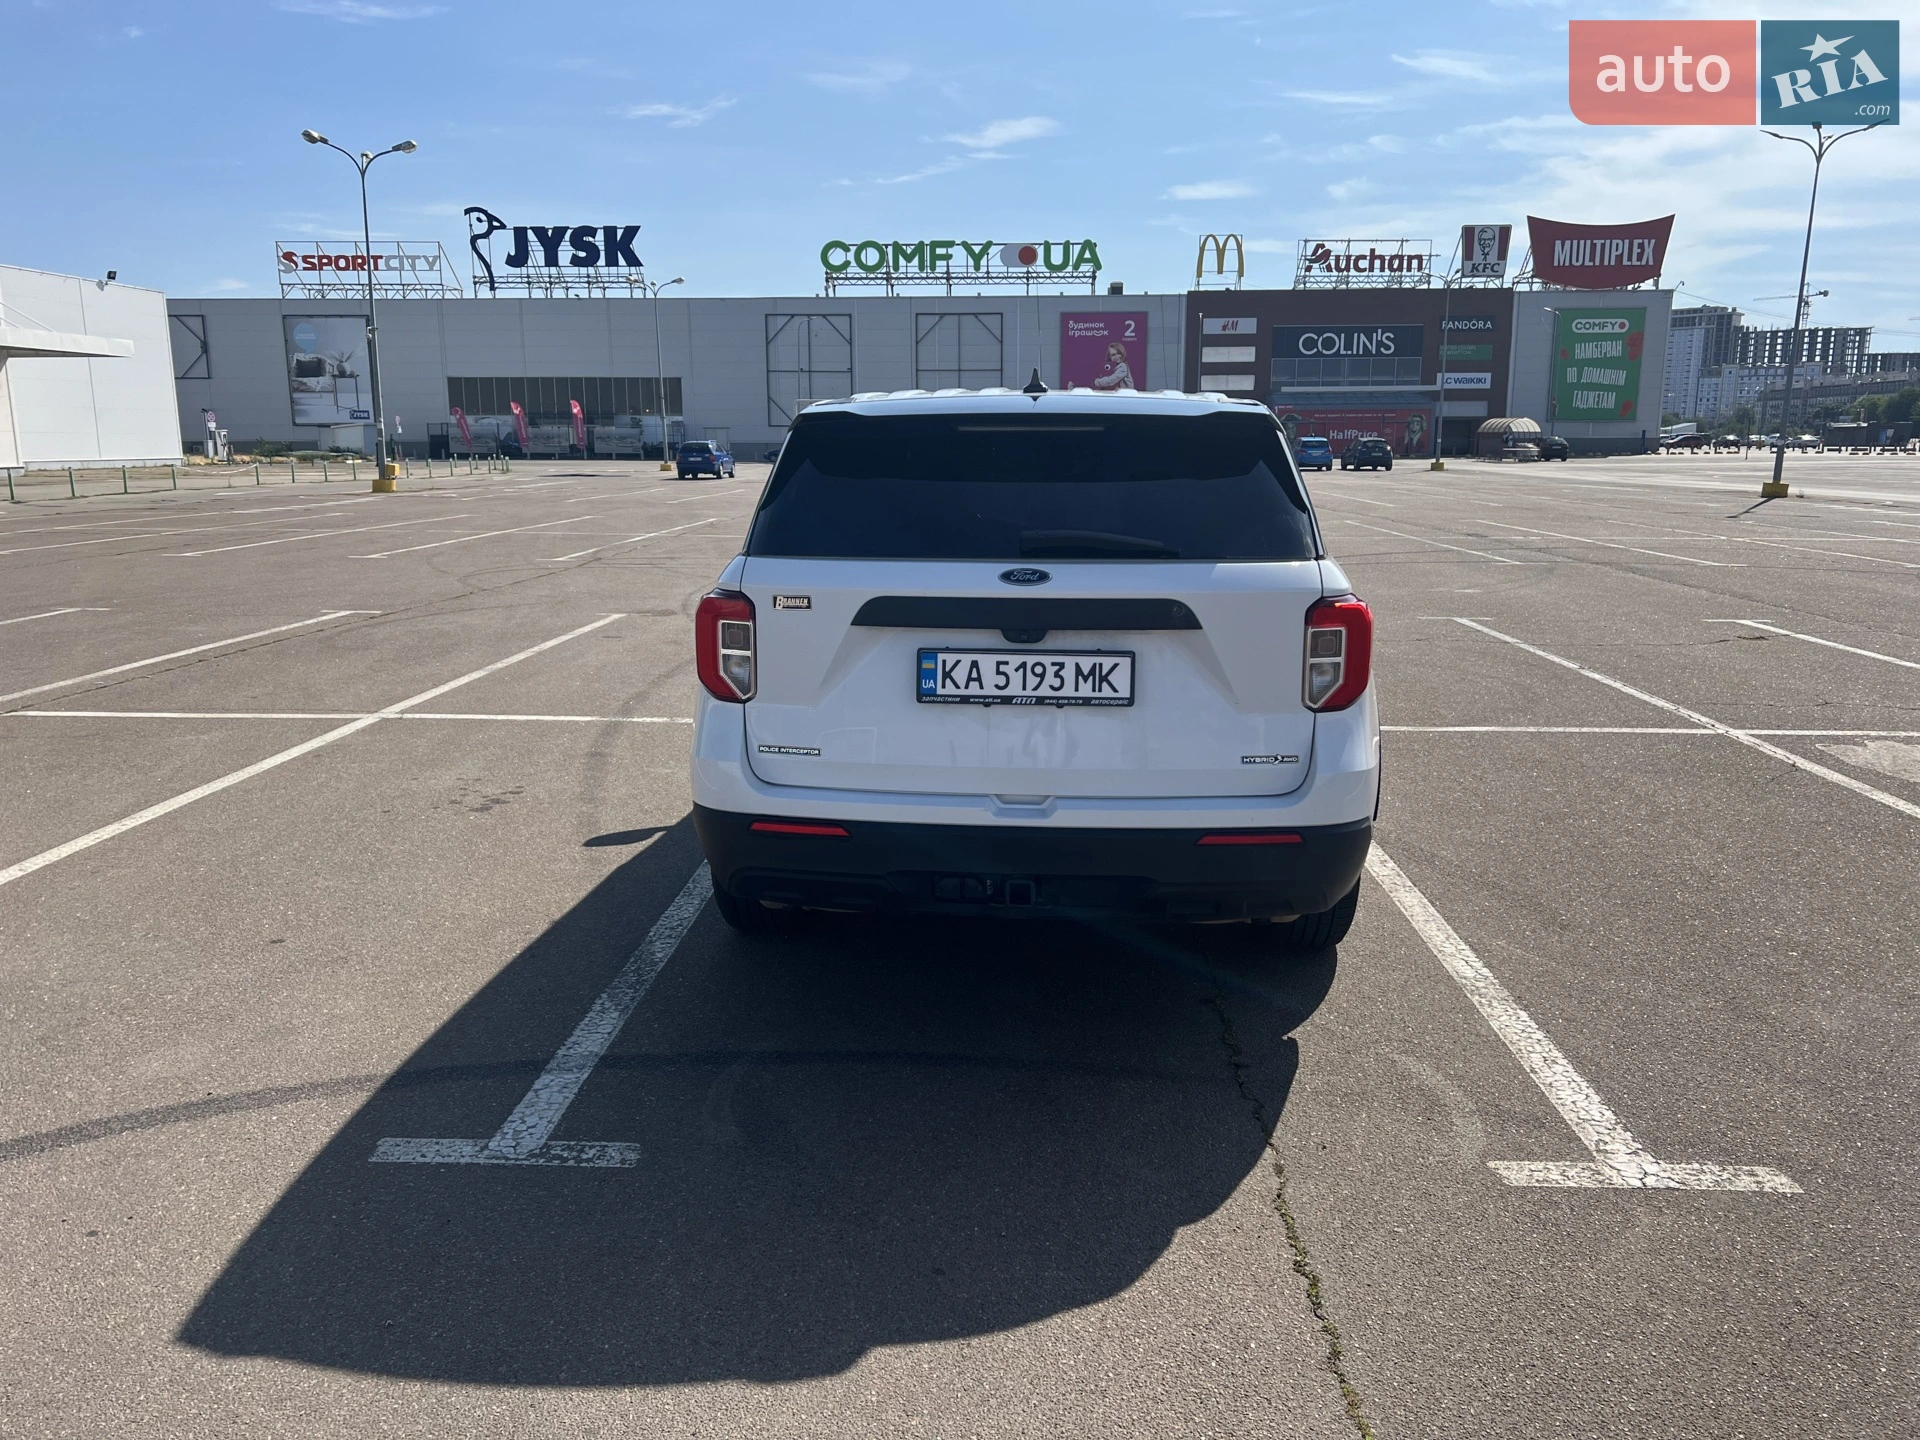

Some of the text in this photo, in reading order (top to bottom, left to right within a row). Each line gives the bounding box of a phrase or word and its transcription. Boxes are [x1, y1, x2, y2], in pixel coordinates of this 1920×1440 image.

[505, 225, 644, 268] JYSK
[820, 239, 1103, 273] COMFY UA
[1553, 239, 1656, 267] MULTIPLEX
[1304, 243, 1424, 273] Auchan
[1469, 262, 1501, 274] KFC
[1068, 320, 1105, 330] будинок
[1124, 320, 1136, 337] 2
[1574, 321, 1618, 331] COMFY
[1298, 328, 1396, 355] COLIN'S
[1575, 340, 1623, 360] НАМБЕРВАН
[1566, 366, 1627, 386] ПО ДОМАШНІМ
[1572, 390, 1617, 410] ГАДЖЕТАМ
[1329, 429, 1378, 440] HalfPrice
[1010, 570, 1040, 581] Ford
[922, 679, 936, 689] UA
[941, 659, 1121, 693] KA 5193 MK
